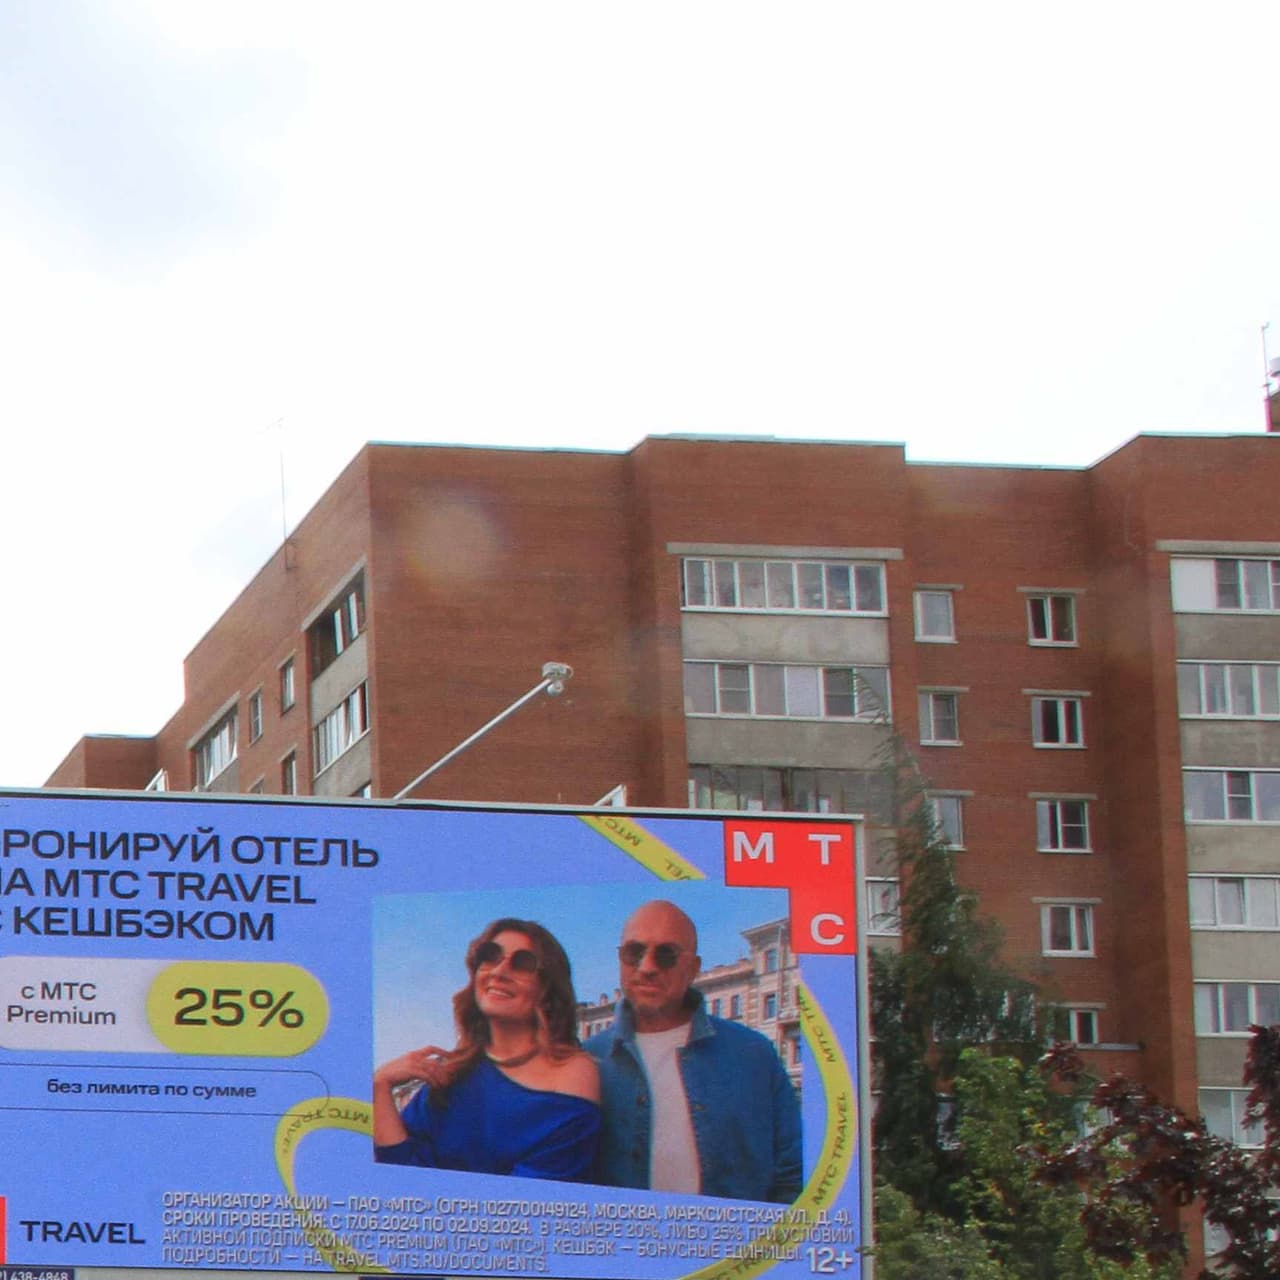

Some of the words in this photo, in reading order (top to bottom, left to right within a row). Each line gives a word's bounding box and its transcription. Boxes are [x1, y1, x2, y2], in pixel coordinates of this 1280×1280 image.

[231, 835, 379, 868] ОТЕЛЬ
[733, 831, 775, 864] М
[808, 833, 841, 865] Т
[45, 869, 139, 900] МТС
[148, 871, 316, 904] TRAVEL
[13, 906, 274, 941] КЕШБЭКОМ
[810, 913, 844, 946] С
[21, 986, 35, 1001] с
[41, 982, 96, 1001] МТС
[7, 1004, 116, 1026] Premium
[174, 987, 304, 1029] 25%
[47, 1078, 83, 1094] без
[88, 1081, 159, 1096] лимита
[165, 1083, 189, 1097] по
[193, 1084, 257, 1101] сумме
[162, 1191, 272, 1209] ОРГАНИЗАТОР
[275, 1194, 328, 1211] АКЦИИ
[348, 1196, 380, 1212] ПАО
[435, 1196, 479, 1215] (ОГРН
[665, 1205, 785, 1223] МАРКСИСТСКАЯ
[19, 1220, 146, 1245] TRAVEL
[162, 1210, 215, 1226] СРОКИ
[331, 1214, 340, 1230] С
[423, 1216, 445, 1233] ПО
[555, 1221, 622, 1238] РАЗМЕРЕ
[666, 1224, 708, 1240] ЛИБО
[712, 1225, 743, 1241] 25%
[748, 1226, 777, 1242] ПРИ
[162, 1228, 246, 1246] АКТИВНОЙ
[250, 1230, 336, 1249] ПОДПИСКИ
[379, 1233, 448, 1251] PREMIUM
[553, 1240, 616, 1257] КЕШБЭК
[637, 1241, 720, 1259] БОНУСНЫЕ
[162, 1246, 281, 1265] ПОДРОБНОСТИ
[304, 1250, 323, 1266] НА
[807, 1246, 855, 1274] 12+
